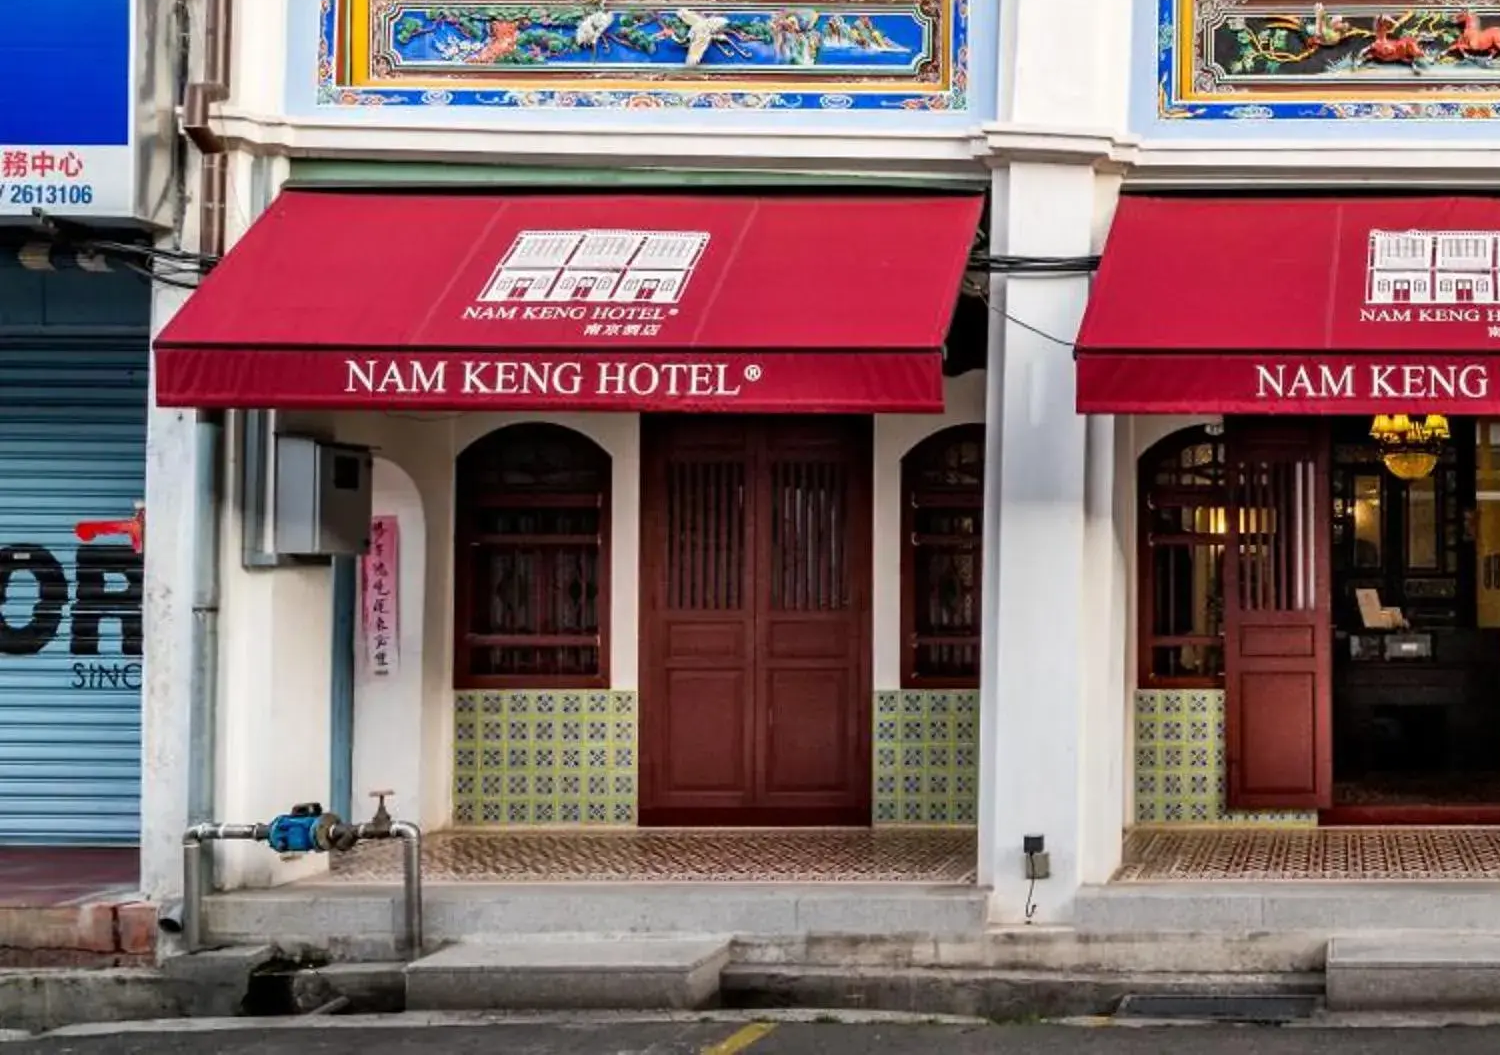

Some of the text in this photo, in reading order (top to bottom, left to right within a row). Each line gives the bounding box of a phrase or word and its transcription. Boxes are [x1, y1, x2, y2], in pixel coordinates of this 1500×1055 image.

[3, 151, 83, 177] 務中心
[10, 184, 93, 204] 2613106
[461, 306, 665, 320] NAM KENG HOTEL
[1359, 308, 1411, 322] NAM
[1418, 308, 1480, 322] KENG
[344, 360, 446, 393] NAM
[461, 361, 582, 395] KENG
[1255, 365, 1354, 398] NAM
[1369, 366, 1488, 399] KENG
